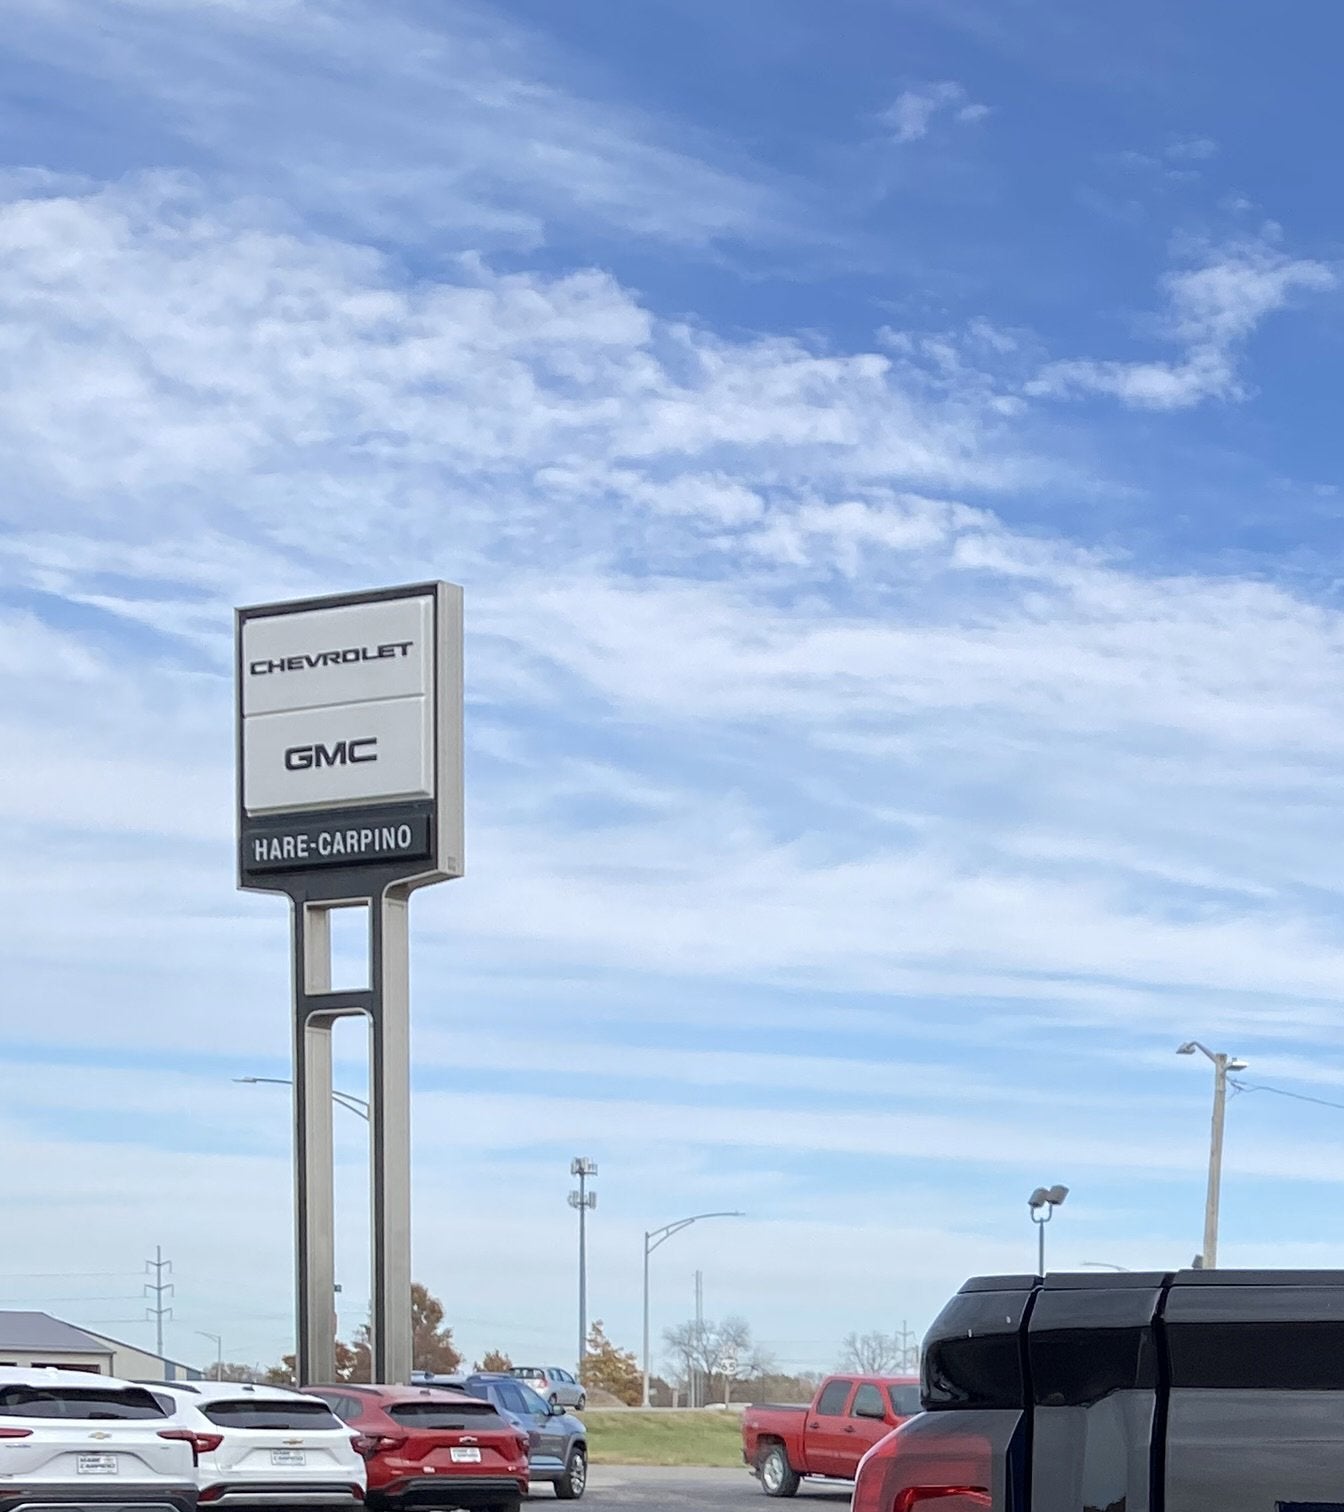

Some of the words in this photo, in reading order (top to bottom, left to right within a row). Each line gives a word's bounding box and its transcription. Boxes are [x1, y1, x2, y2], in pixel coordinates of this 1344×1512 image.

[250, 641, 414, 676] CHEVROLET
[284, 737, 378, 771] GMC
[254, 824, 412, 862] HARE-CARPINO
[720, 1361, 737, 1372] 65
